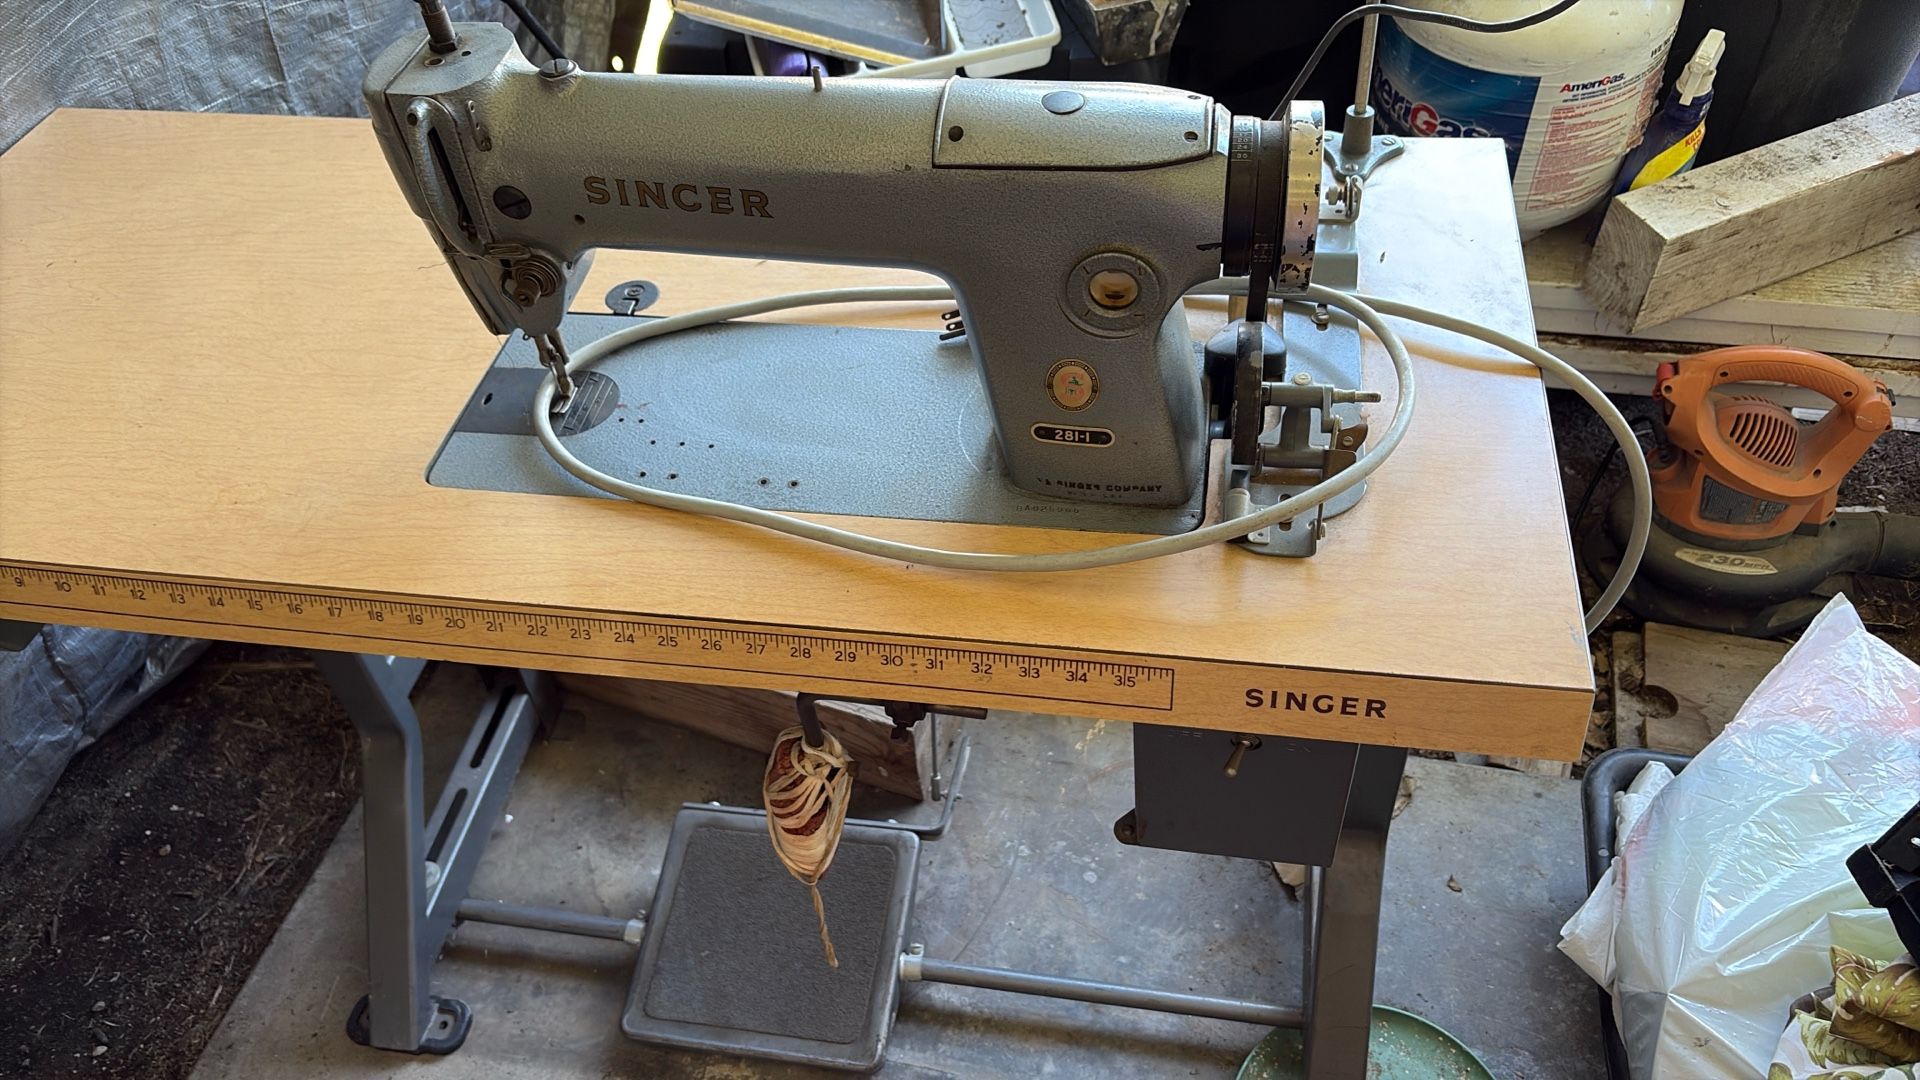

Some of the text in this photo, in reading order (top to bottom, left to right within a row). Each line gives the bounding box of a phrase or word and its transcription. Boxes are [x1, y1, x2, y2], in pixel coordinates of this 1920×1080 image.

[1373, 66, 1491, 138] eriGa
[1054, 429, 1091, 443] 281-1
[1696, 553, 1746, 567] 230
[54, 580, 72, 592] 10
[92, 584, 106, 596] 11
[130, 588, 146, 600] 12
[169, 592, 186, 605] 13
[208, 597, 225, 608] 14
[247, 598, 263, 612] 15
[287, 602, 303, 615] 16
[327, 606, 343, 618] 17
[368, 610, 384, 622] 18
[407, 613, 424, 625] 19
[445, 618, 466, 629] 20
[486, 620, 504, 633] 21
[527, 624, 548, 637] 22
[570, 628, 592, 640] 23
[614, 632, 635, 644] 24
[658, 636, 678, 648] 25
[701, 639, 722, 651] 26
[746, 643, 766, 655] 27
[790, 646, 812, 659] 28
[834, 650, 857, 663] 29
[880, 654, 904, 667] 30
[925, 658, 944, 671] 31
[971, 662, 993, 675] 32
[1018, 666, 1041, 679] 33
[1065, 670, 1088, 683] 34
[1113, 675, 1136, 688] 35
[1244, 687, 1388, 719] SINGER
